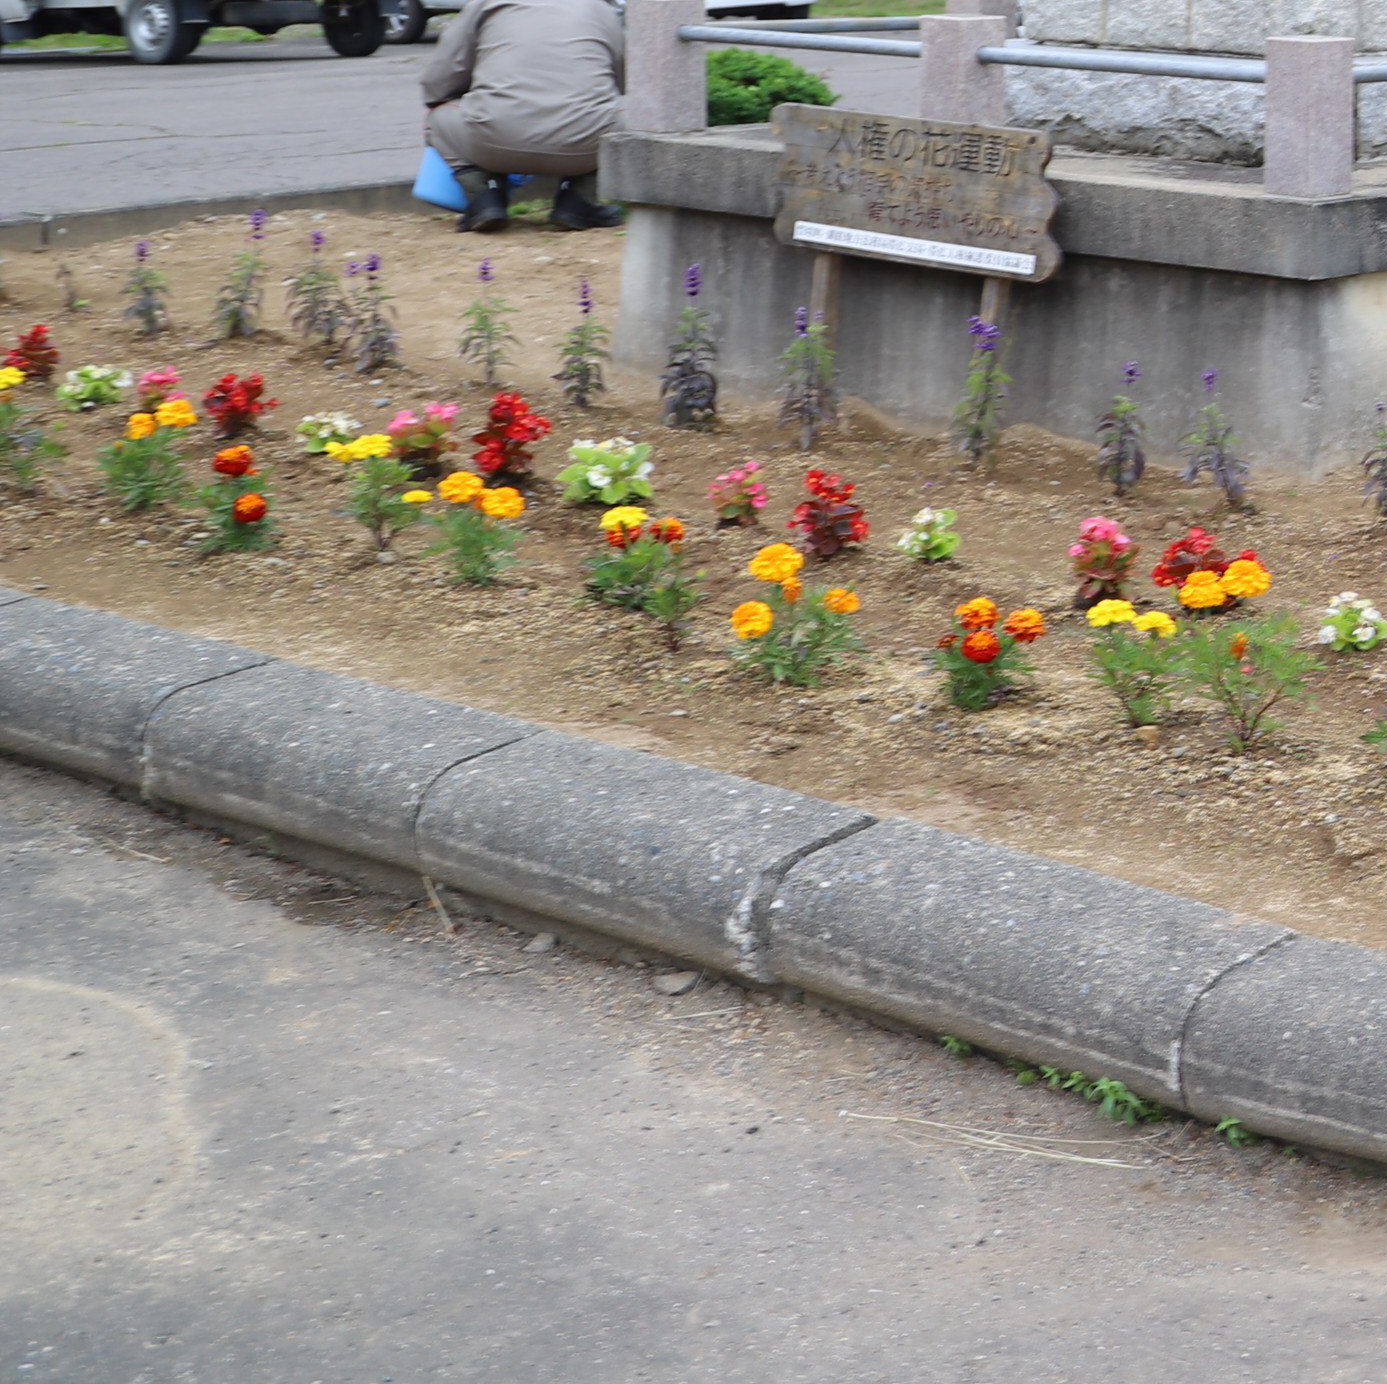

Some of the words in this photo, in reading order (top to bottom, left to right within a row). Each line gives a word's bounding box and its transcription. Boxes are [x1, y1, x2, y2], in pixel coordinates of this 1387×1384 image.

[828, 118, 1019, 177] 人権の花運動
